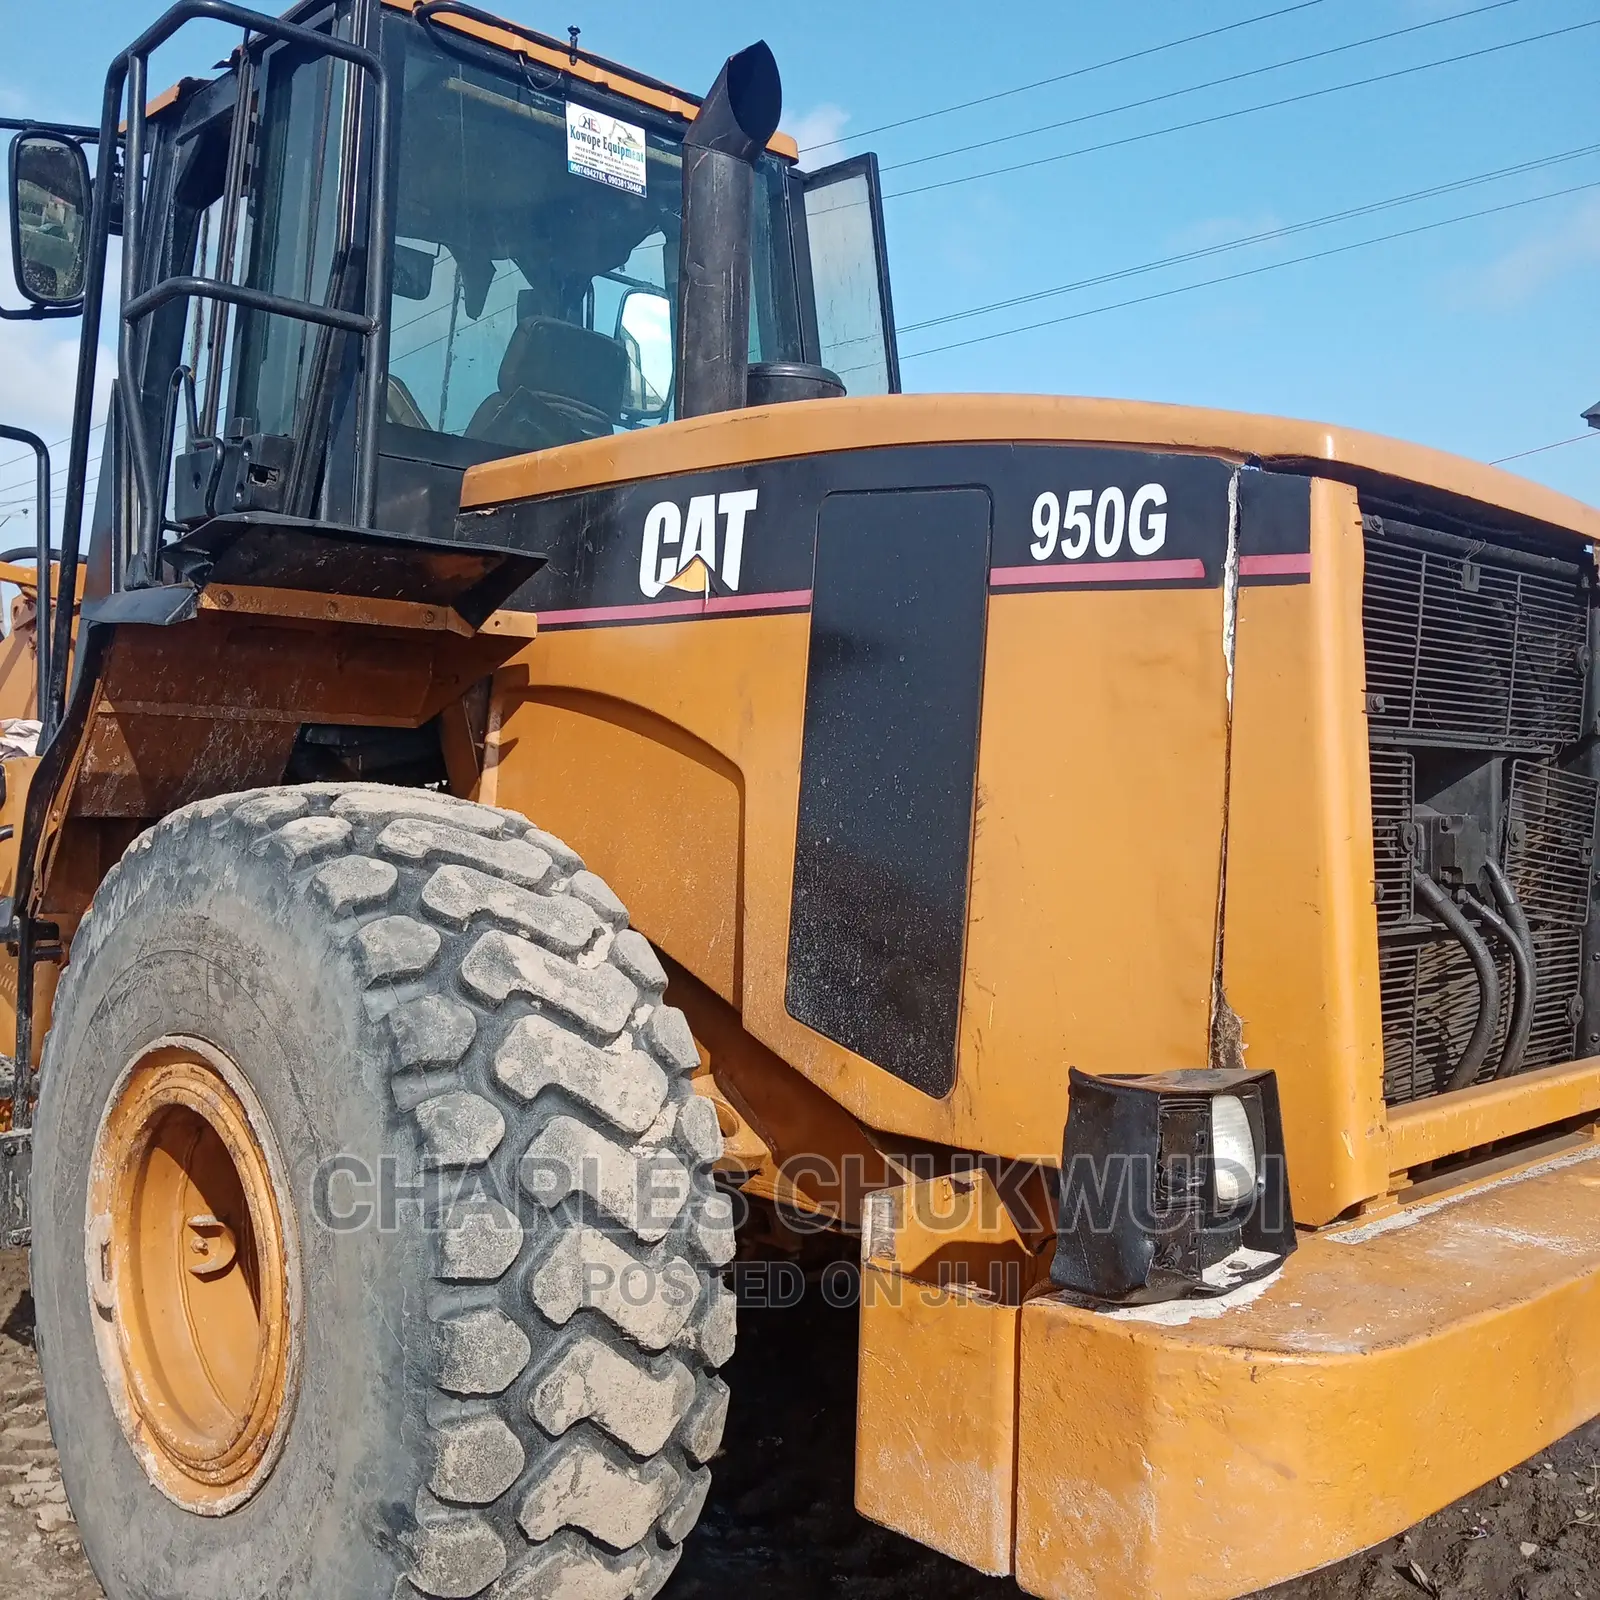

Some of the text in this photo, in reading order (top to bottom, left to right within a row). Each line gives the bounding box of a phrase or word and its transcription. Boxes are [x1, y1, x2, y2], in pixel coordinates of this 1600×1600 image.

[570, 124, 601, 150] Kowope
[603, 136, 644, 163] Equipment
[639, 488, 759, 598] CAT
[1029, 482, 1168, 561] 950G
